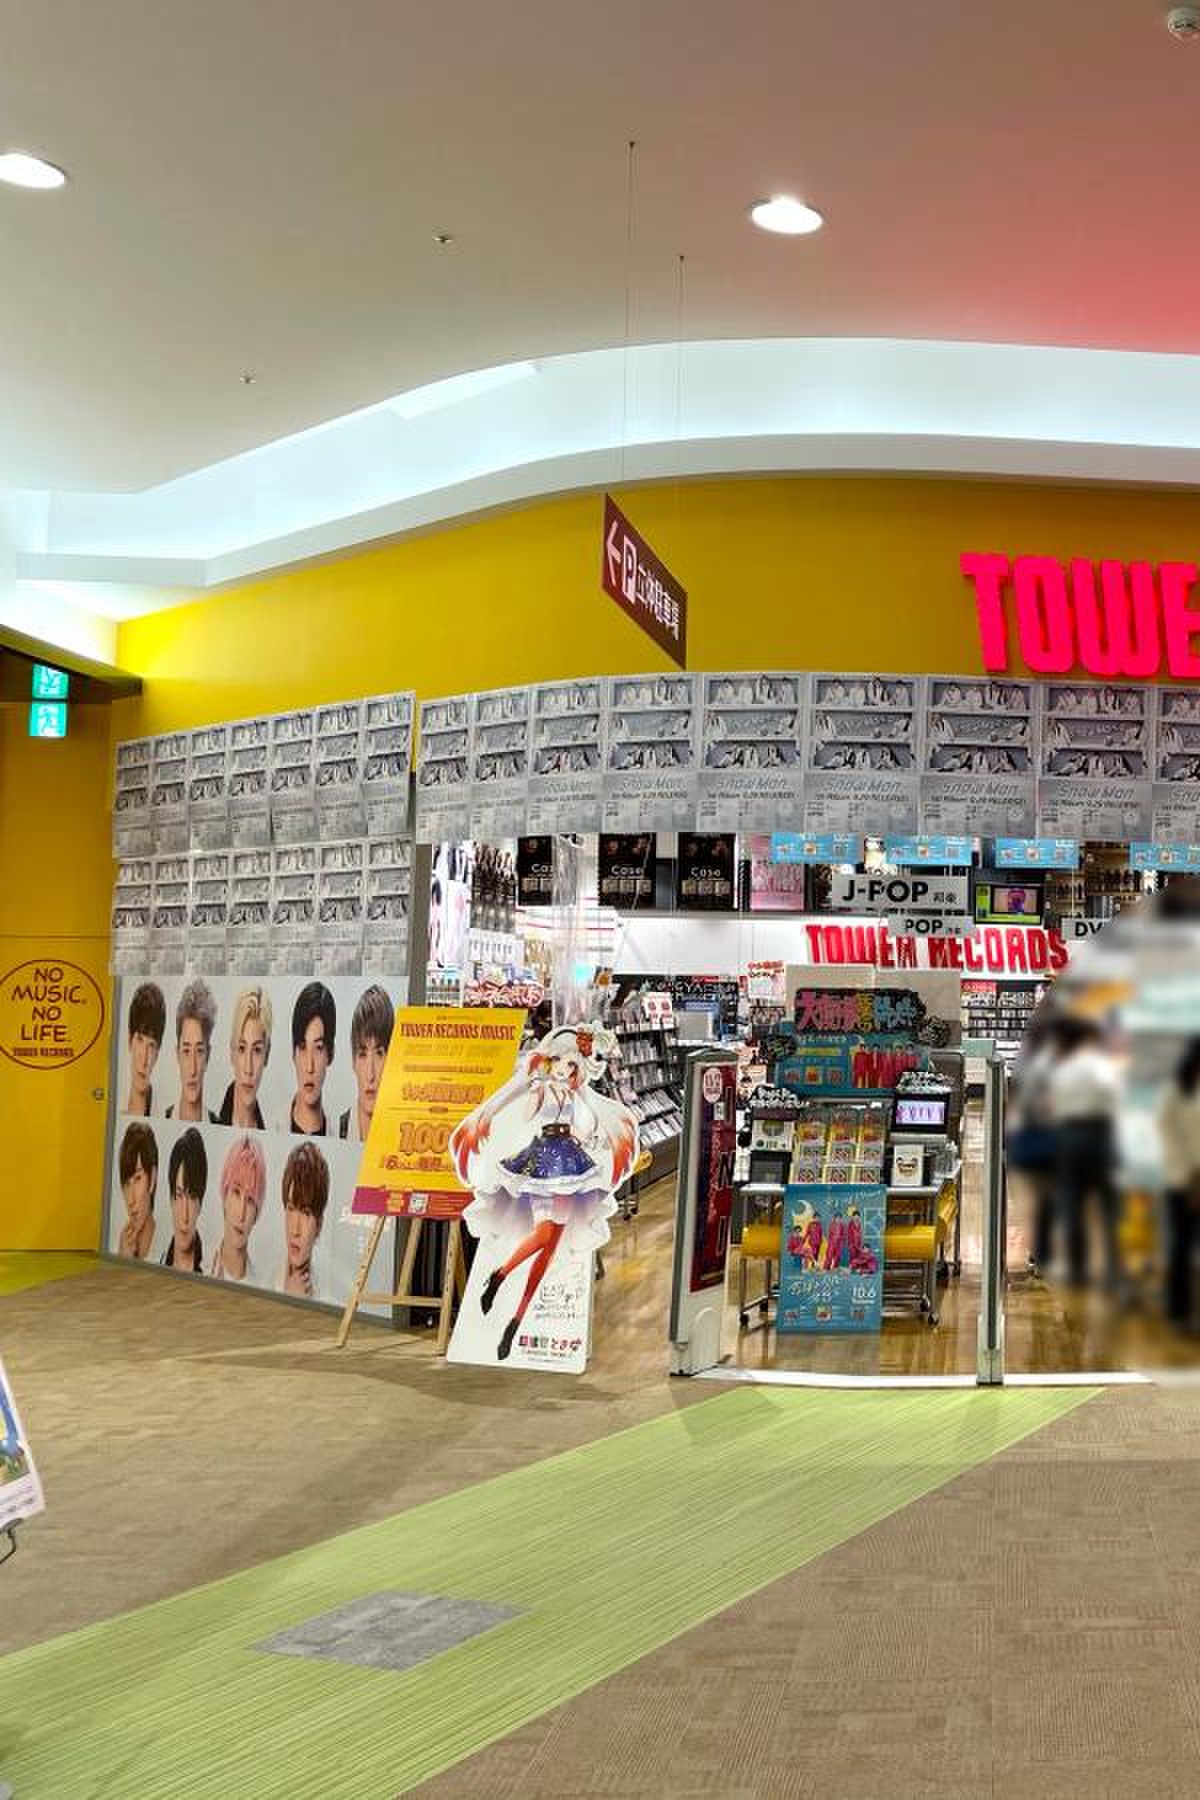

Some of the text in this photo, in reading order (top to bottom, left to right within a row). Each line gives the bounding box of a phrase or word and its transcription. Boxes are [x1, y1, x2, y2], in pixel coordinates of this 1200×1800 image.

[842, 880, 929, 903] J-POP
[906, 919, 944, 936] POP
[805, 924, 1069, 974] TOWER RECORDS
[33, 966, 64, 982] NO
[32, 1006, 62, 1021] NO
